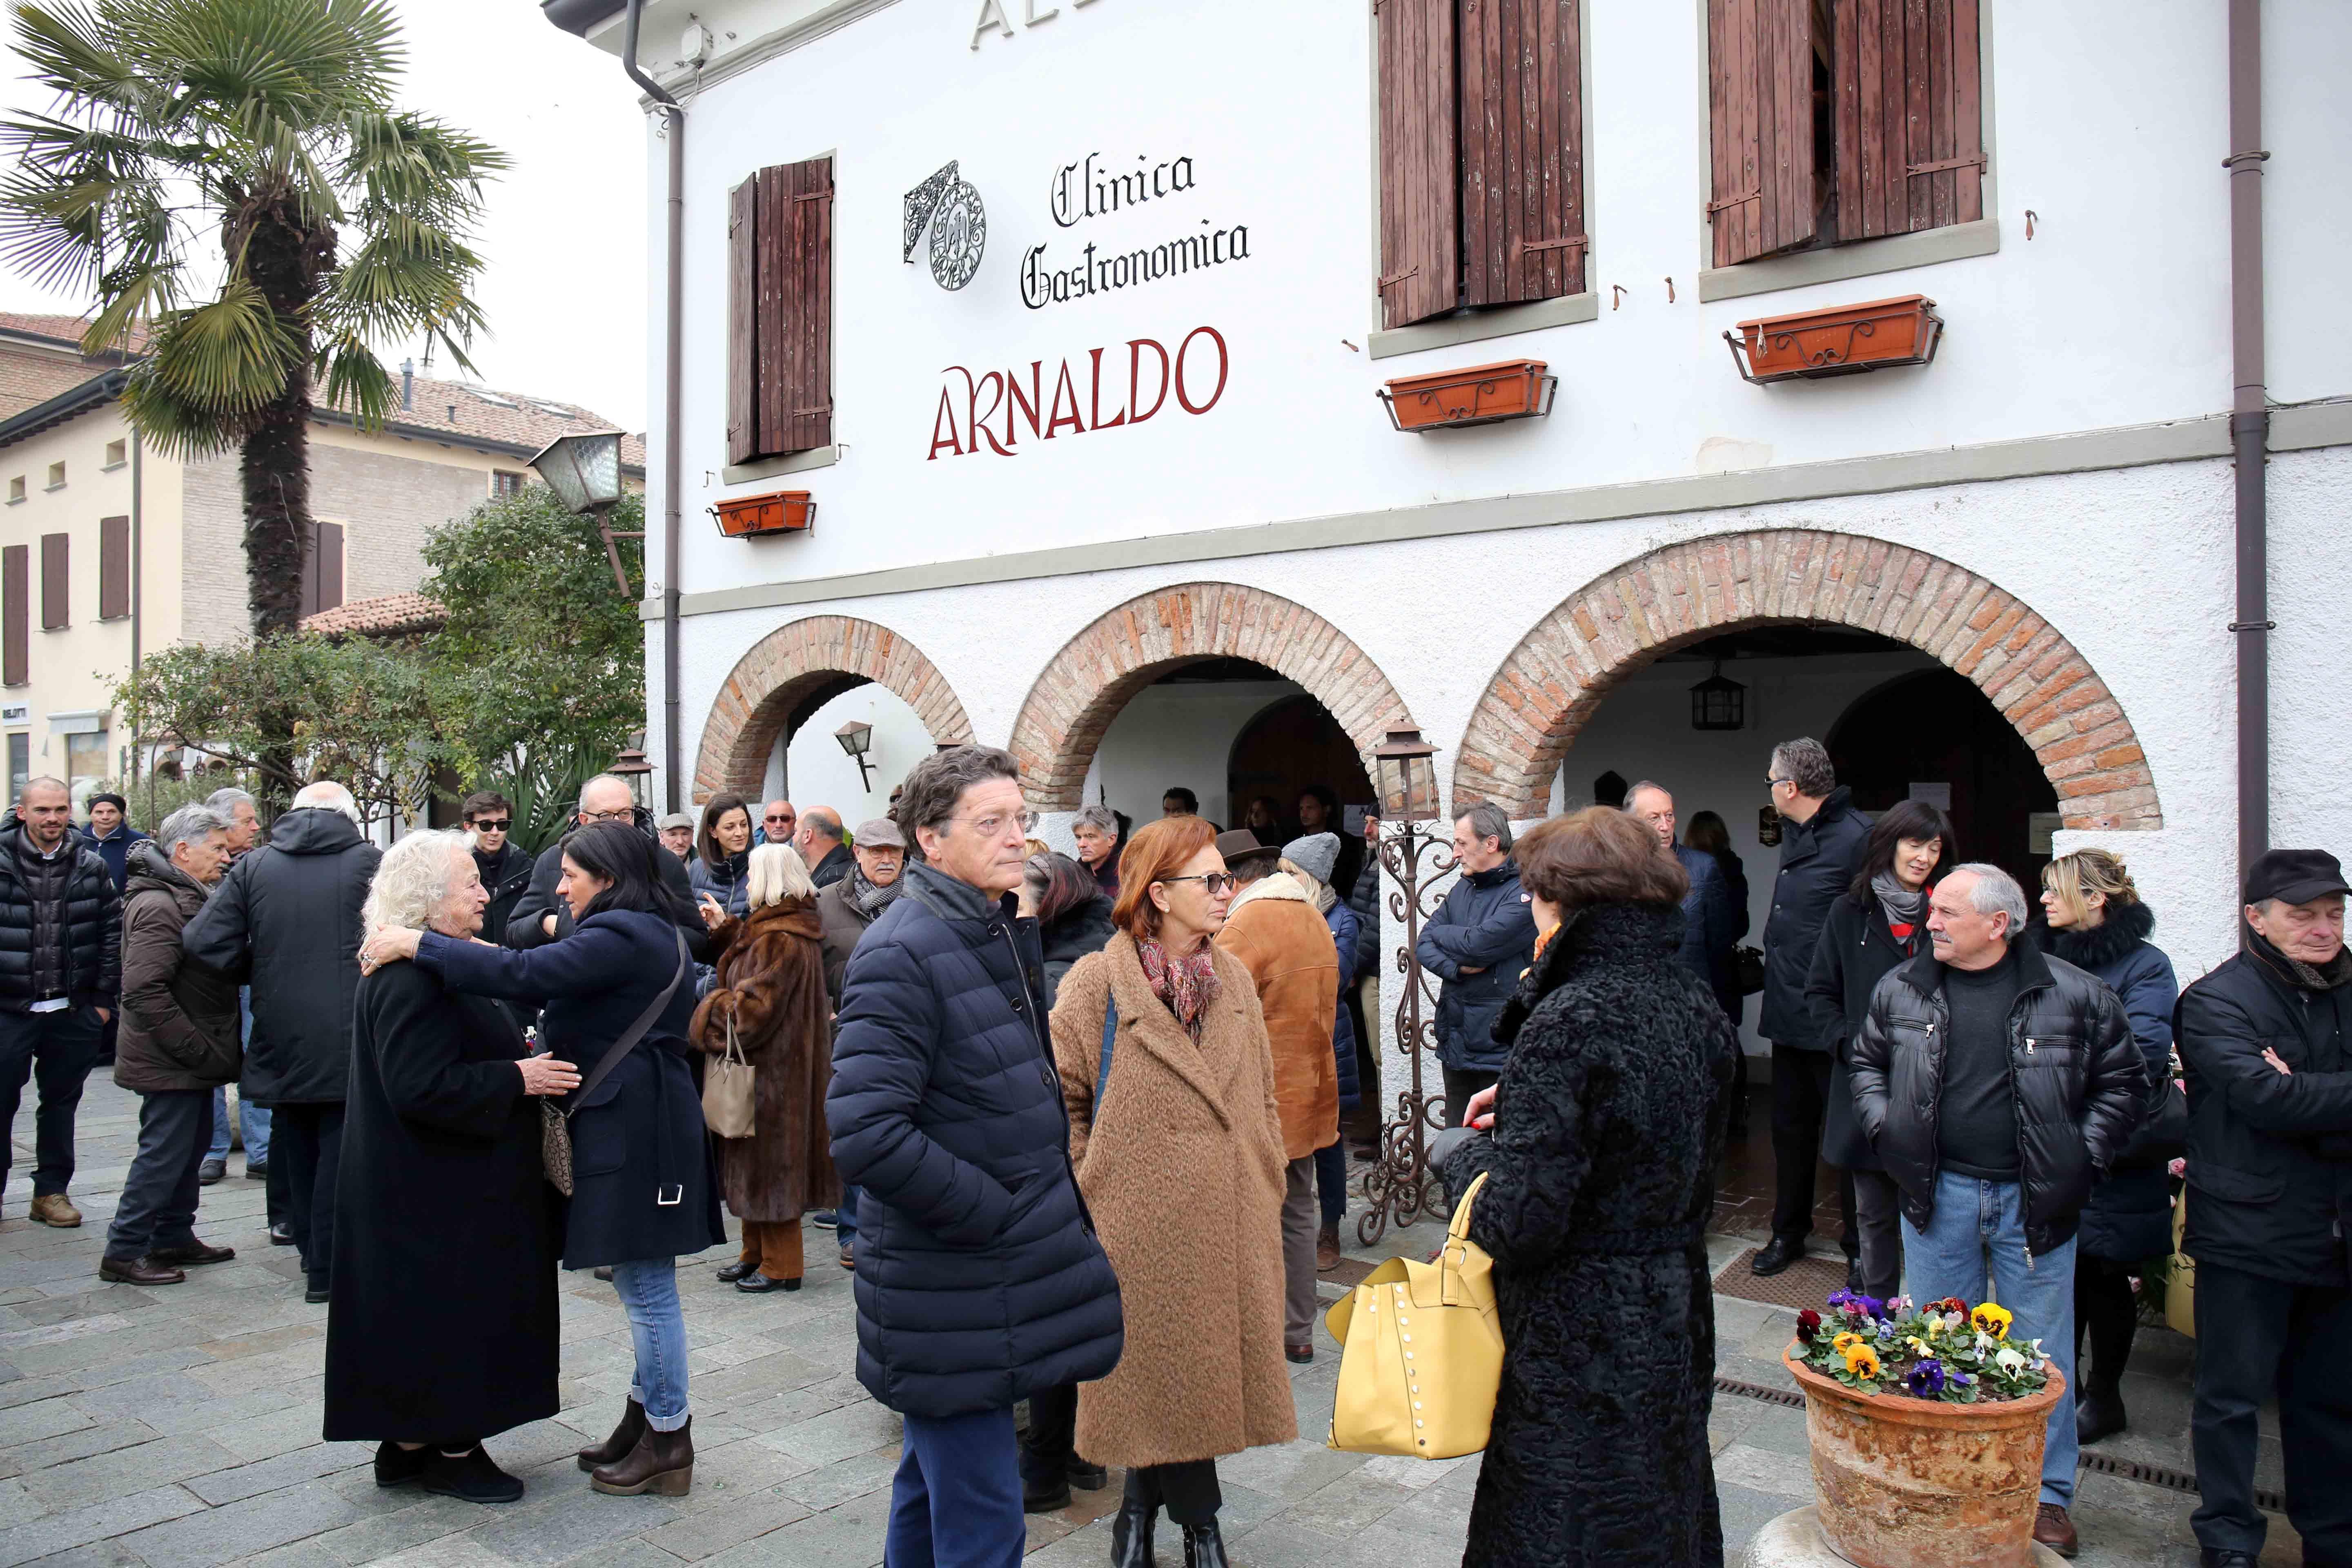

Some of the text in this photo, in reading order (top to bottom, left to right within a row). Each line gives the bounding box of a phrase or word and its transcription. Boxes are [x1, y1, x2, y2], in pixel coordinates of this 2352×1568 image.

[1051, 151, 1196, 228] Clinica
[1020, 218, 1251, 310] Gastronomica
[926, 326, 1228, 461] ARNALDO
